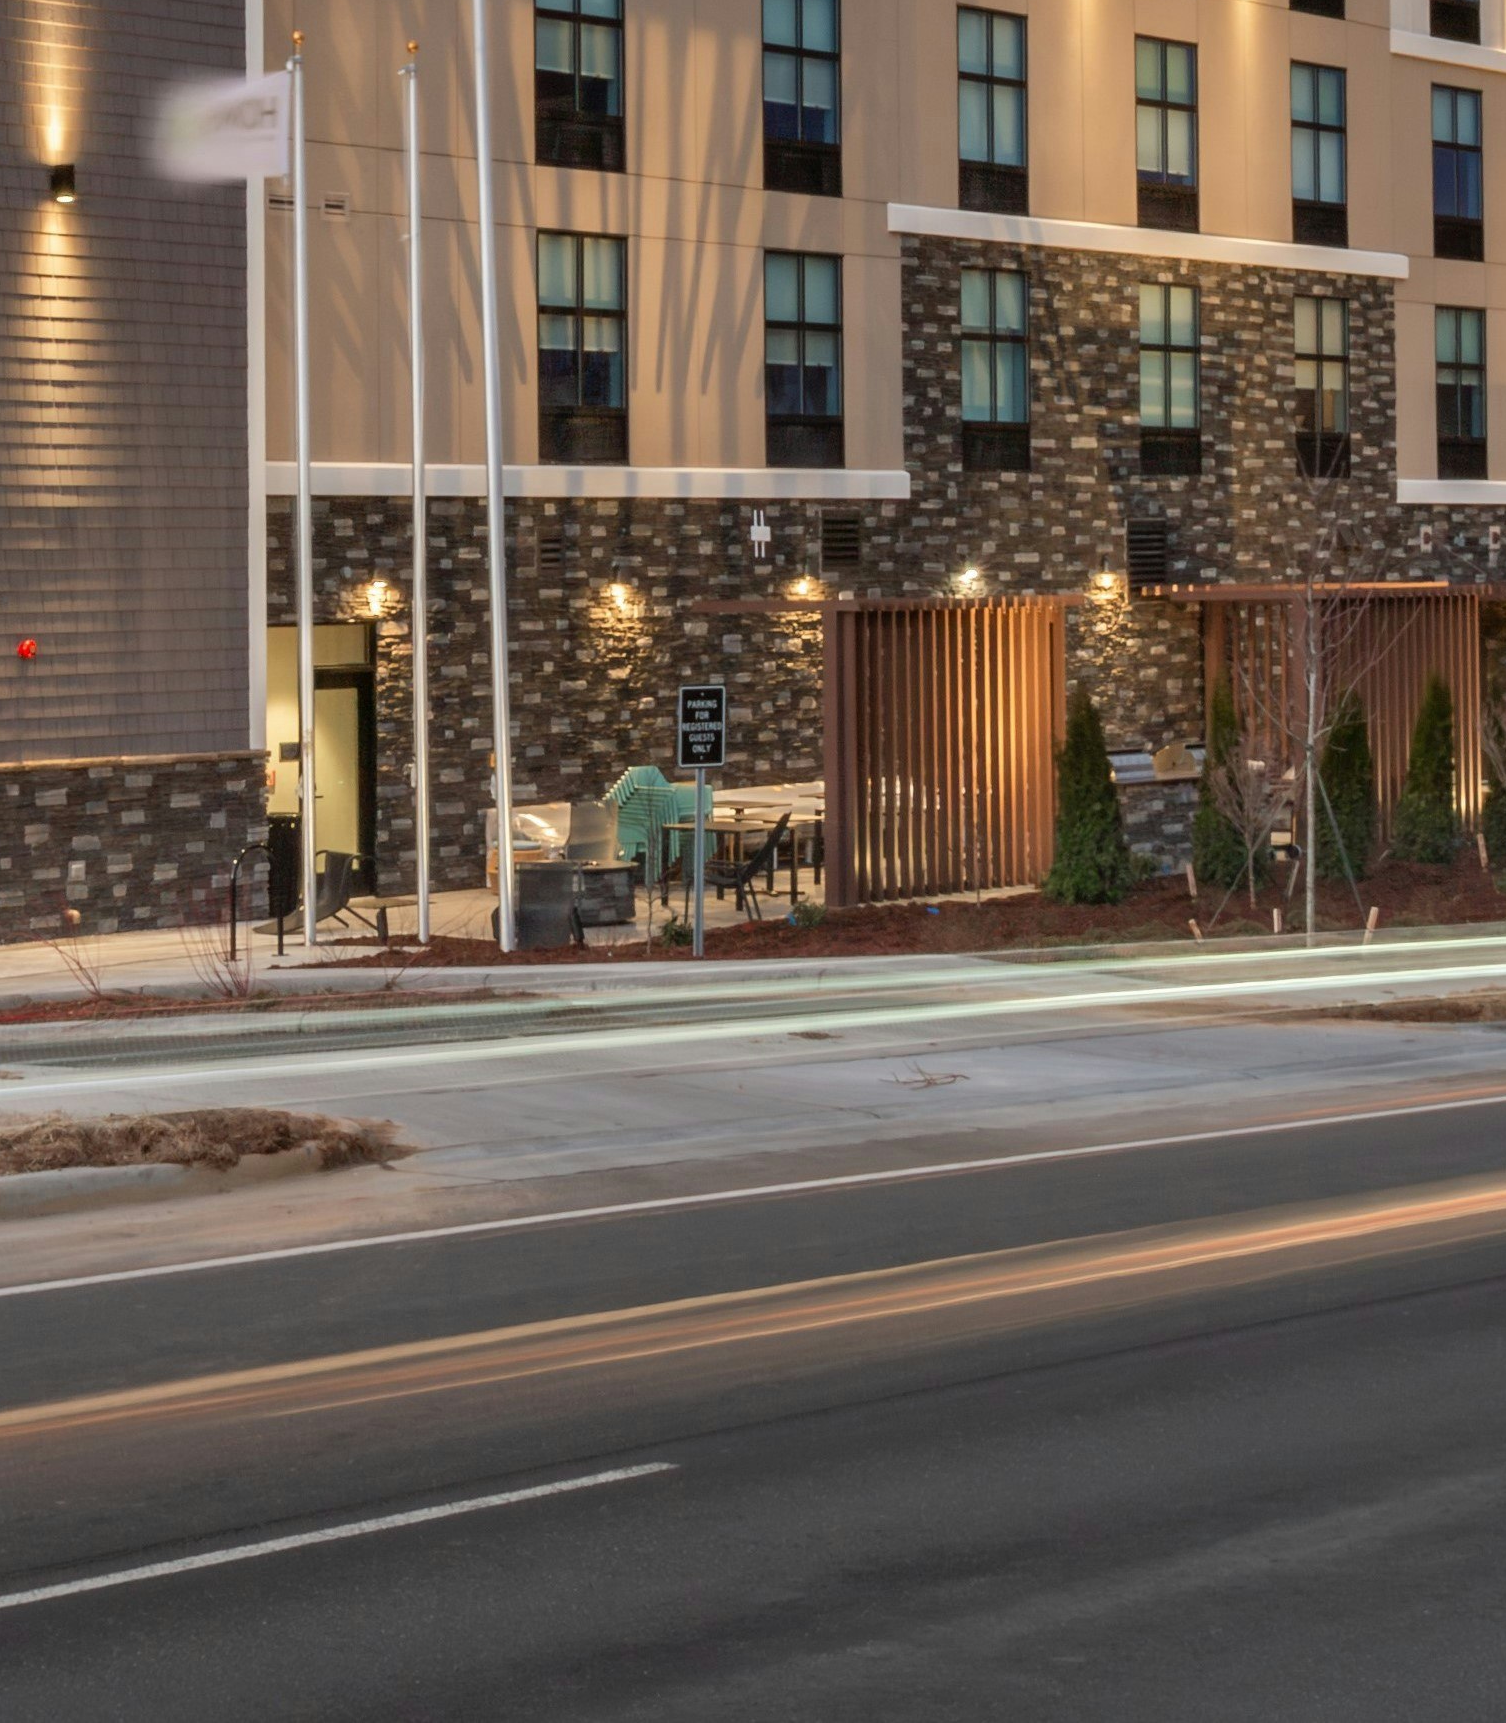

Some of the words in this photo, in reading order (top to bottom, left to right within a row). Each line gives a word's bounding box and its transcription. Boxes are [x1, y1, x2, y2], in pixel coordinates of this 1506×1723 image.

[687, 699, 718, 709] PARKING
[695, 710, 710, 720] FOR
[681, 721, 723, 732] REGISTERED
[688, 732, 715, 742] GUESTS
[692, 743, 712, 753] ONLY
